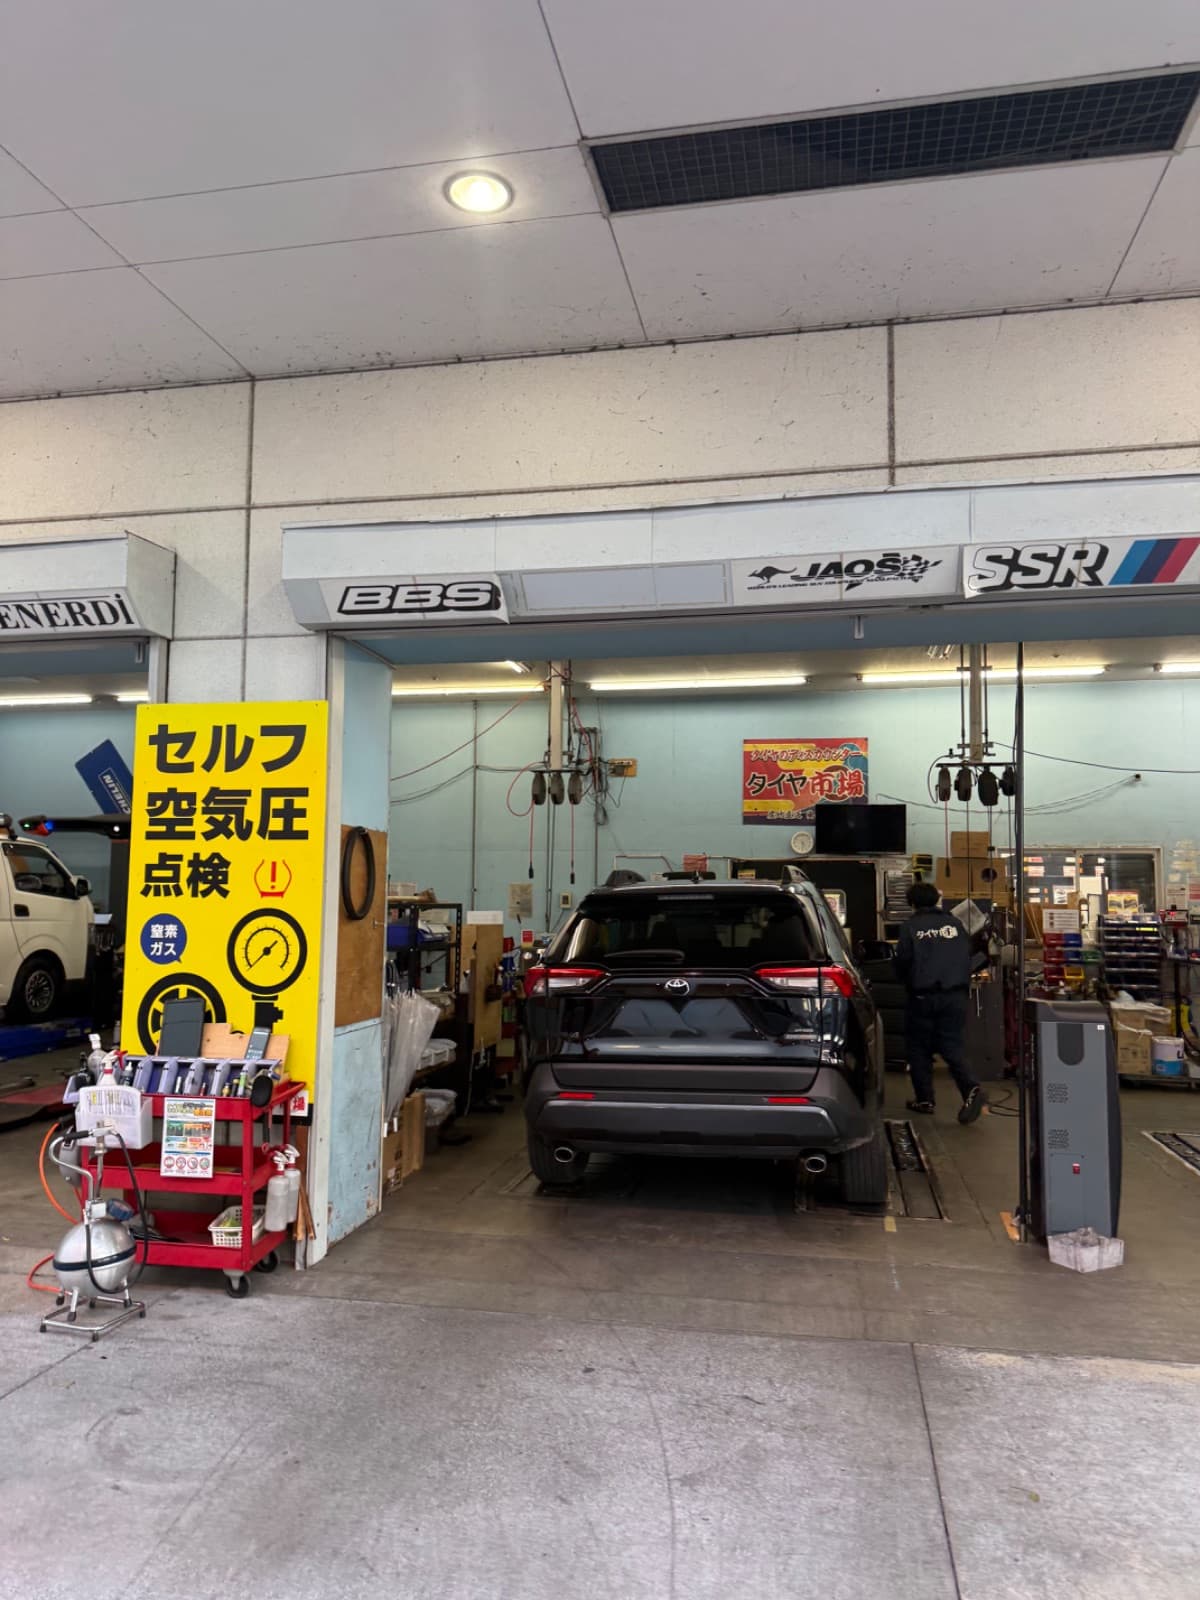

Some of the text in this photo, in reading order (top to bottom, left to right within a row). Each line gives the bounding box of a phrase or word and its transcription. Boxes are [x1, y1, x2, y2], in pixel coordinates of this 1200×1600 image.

[790, 553, 902, 581] JAOS
[968, 543, 1109, 592] SSR
[337, 581, 501, 615] BBS
[149, 724, 307, 774] セルフ
[747, 769, 865, 797] タイヤ市場
[145, 787, 309, 840] 空気圧
[140, 852, 231, 899] 点検
[150, 924, 178, 938] 窒素
[150, 942, 177, 956] ガス
